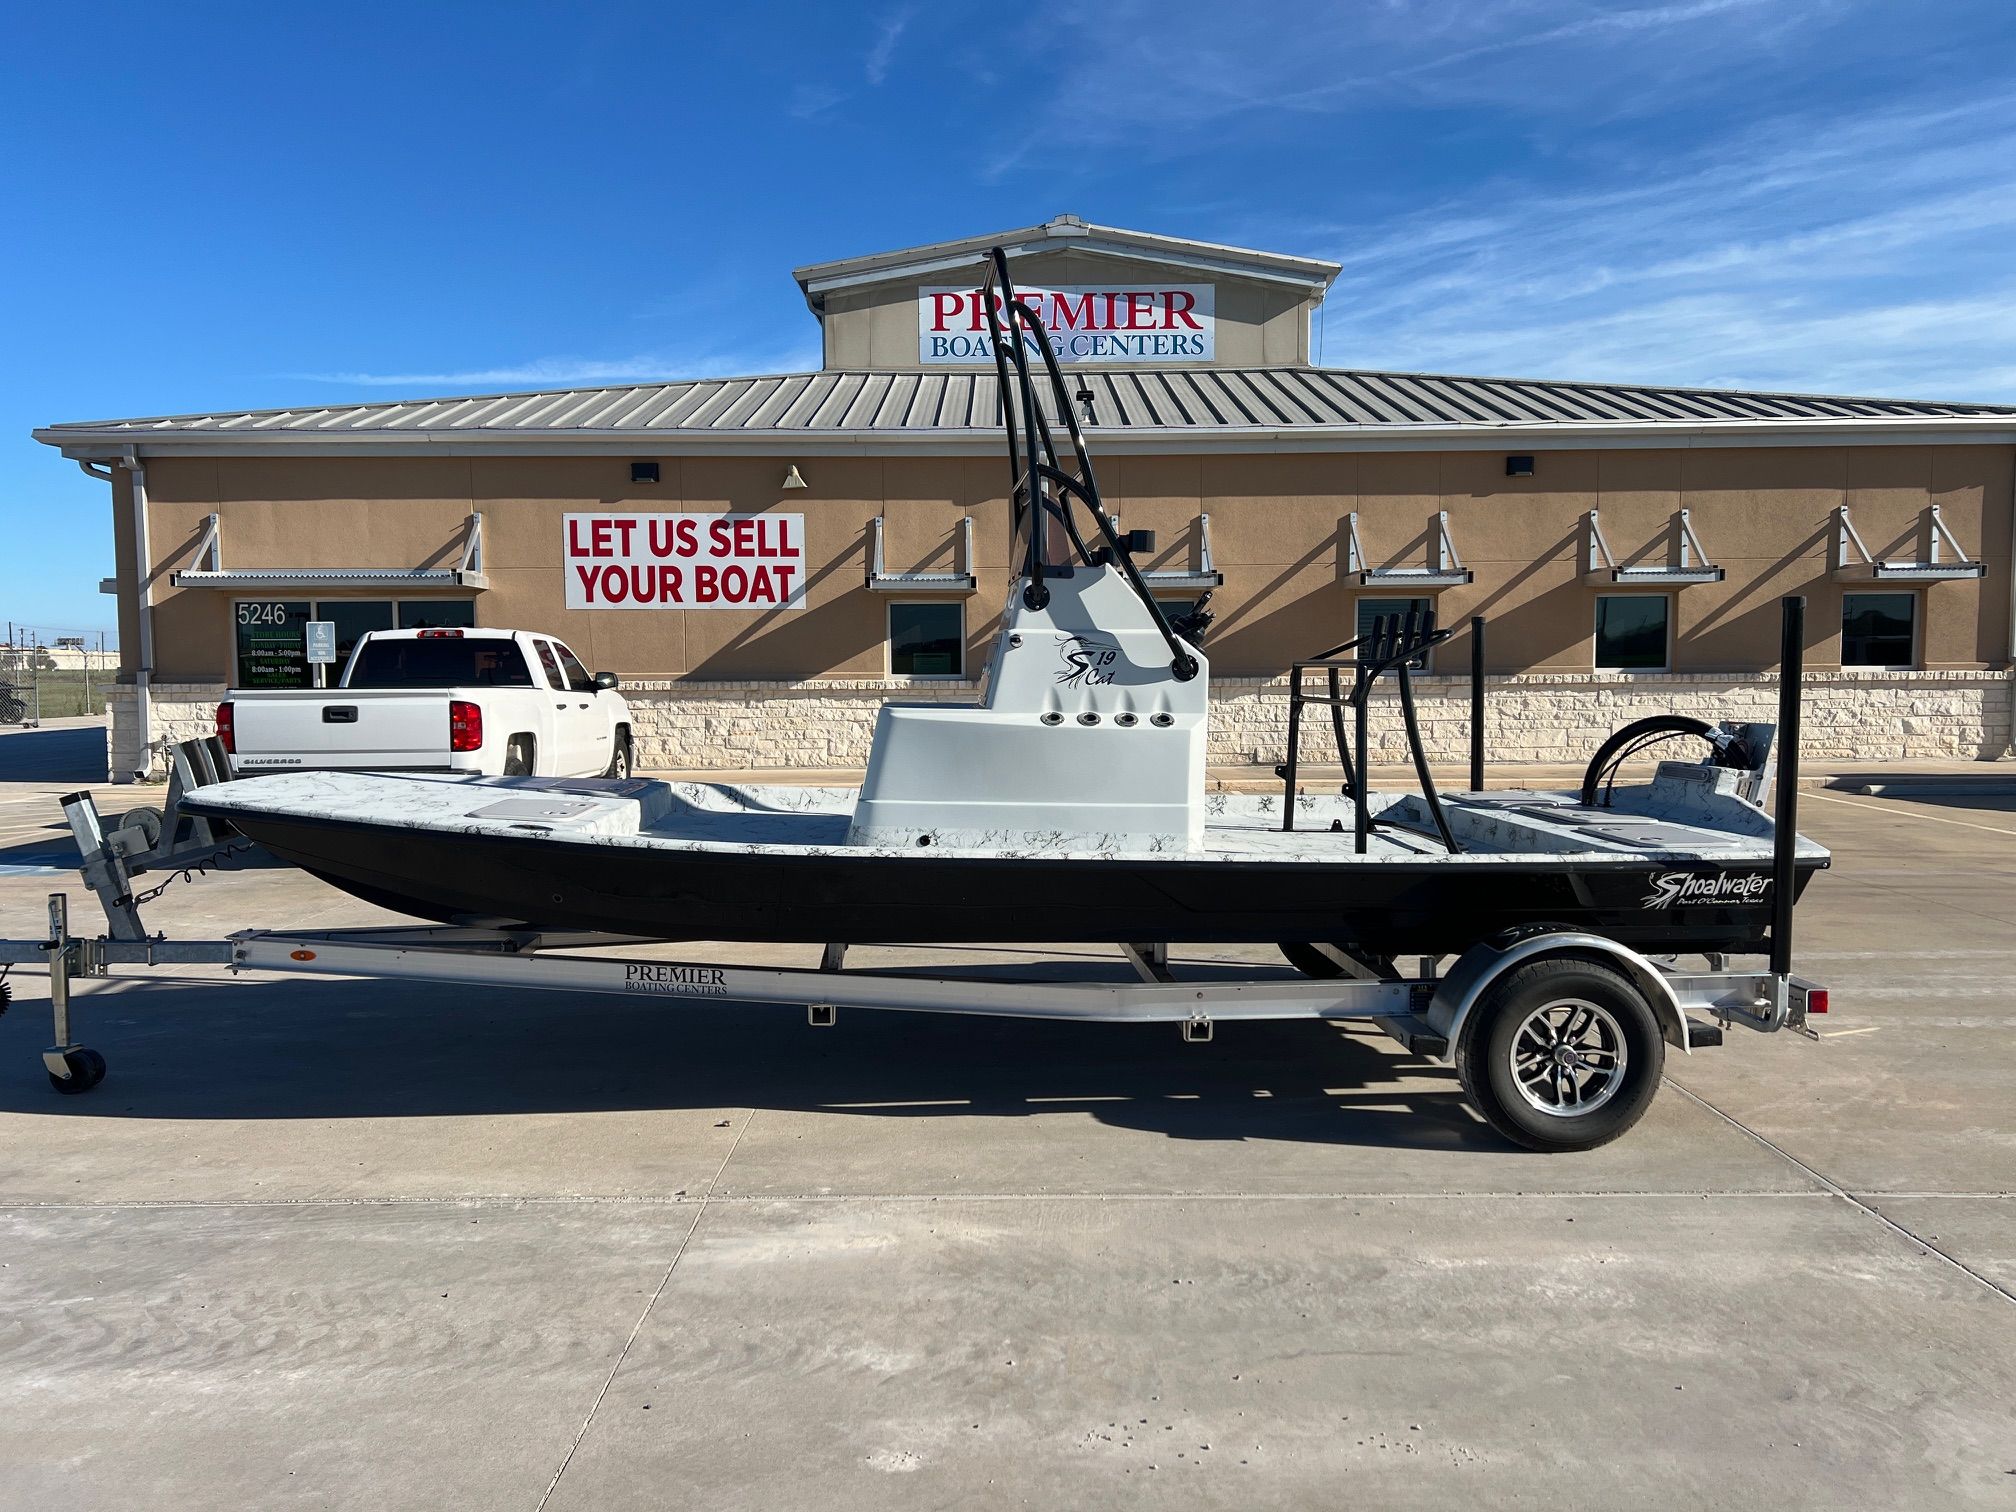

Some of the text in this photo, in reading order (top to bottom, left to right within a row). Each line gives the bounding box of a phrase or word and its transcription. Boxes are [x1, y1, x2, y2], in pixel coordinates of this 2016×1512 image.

[930, 290, 1204, 332] PREMIER
[1070, 333, 1204, 357] CENTERS
[569, 519, 800, 558] LET US SELL
[576, 564, 796, 604] YOUR BOAT
[238, 603, 286, 624] 5246
[251, 649, 274, 657] 8:00am
[278, 649, 301, 658] 5:00pm
[1097, 651, 1117, 666] 19
[279, 666, 302, 675] 1:00pm
[1085, 668, 1116, 686] Cat
[1645, 870, 1774, 905] Shoalwater
[625, 964, 727, 986] PREMIER
[625, 981, 728, 995] BOATING CENTERS
